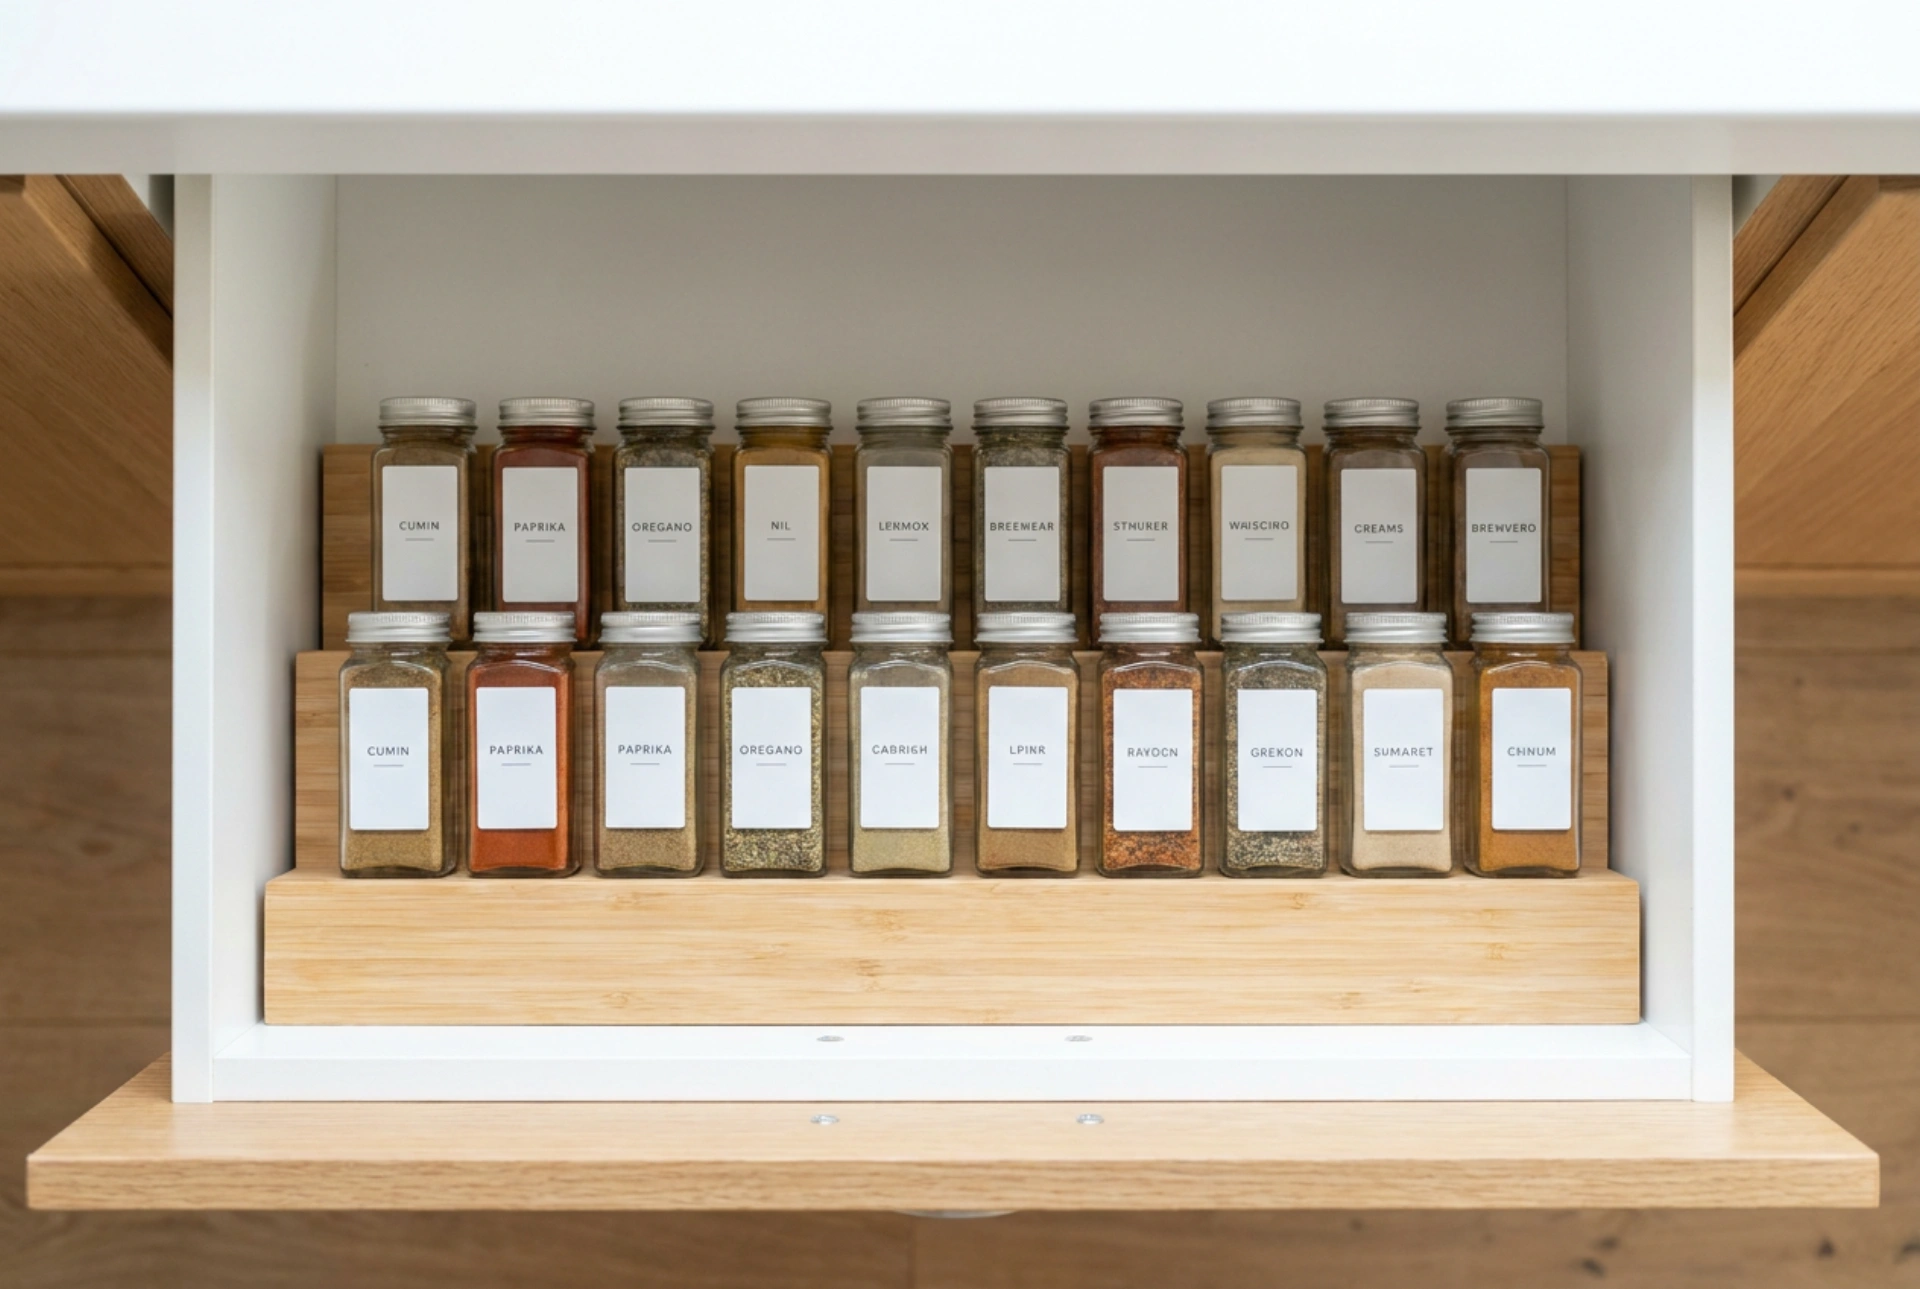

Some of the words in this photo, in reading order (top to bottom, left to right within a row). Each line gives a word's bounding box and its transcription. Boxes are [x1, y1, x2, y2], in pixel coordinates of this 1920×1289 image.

[398, 520, 440, 531] CUMIN
[514, 522, 566, 532] PAPRIKA
[631, 522, 693, 532] OREGANO
[770, 520, 791, 531] NIL
[1354, 523, 1404, 534] CREAMS
[366, 745, 410, 757] CUMIN
[489, 744, 544, 755] PAPRIKA
[617, 744, 672, 755] PAPRIKA
[739, 744, 803, 756] OREGANO
[1250, 747, 1303, 758] GREKON
[1374, 746, 1434, 758] SUMARET
